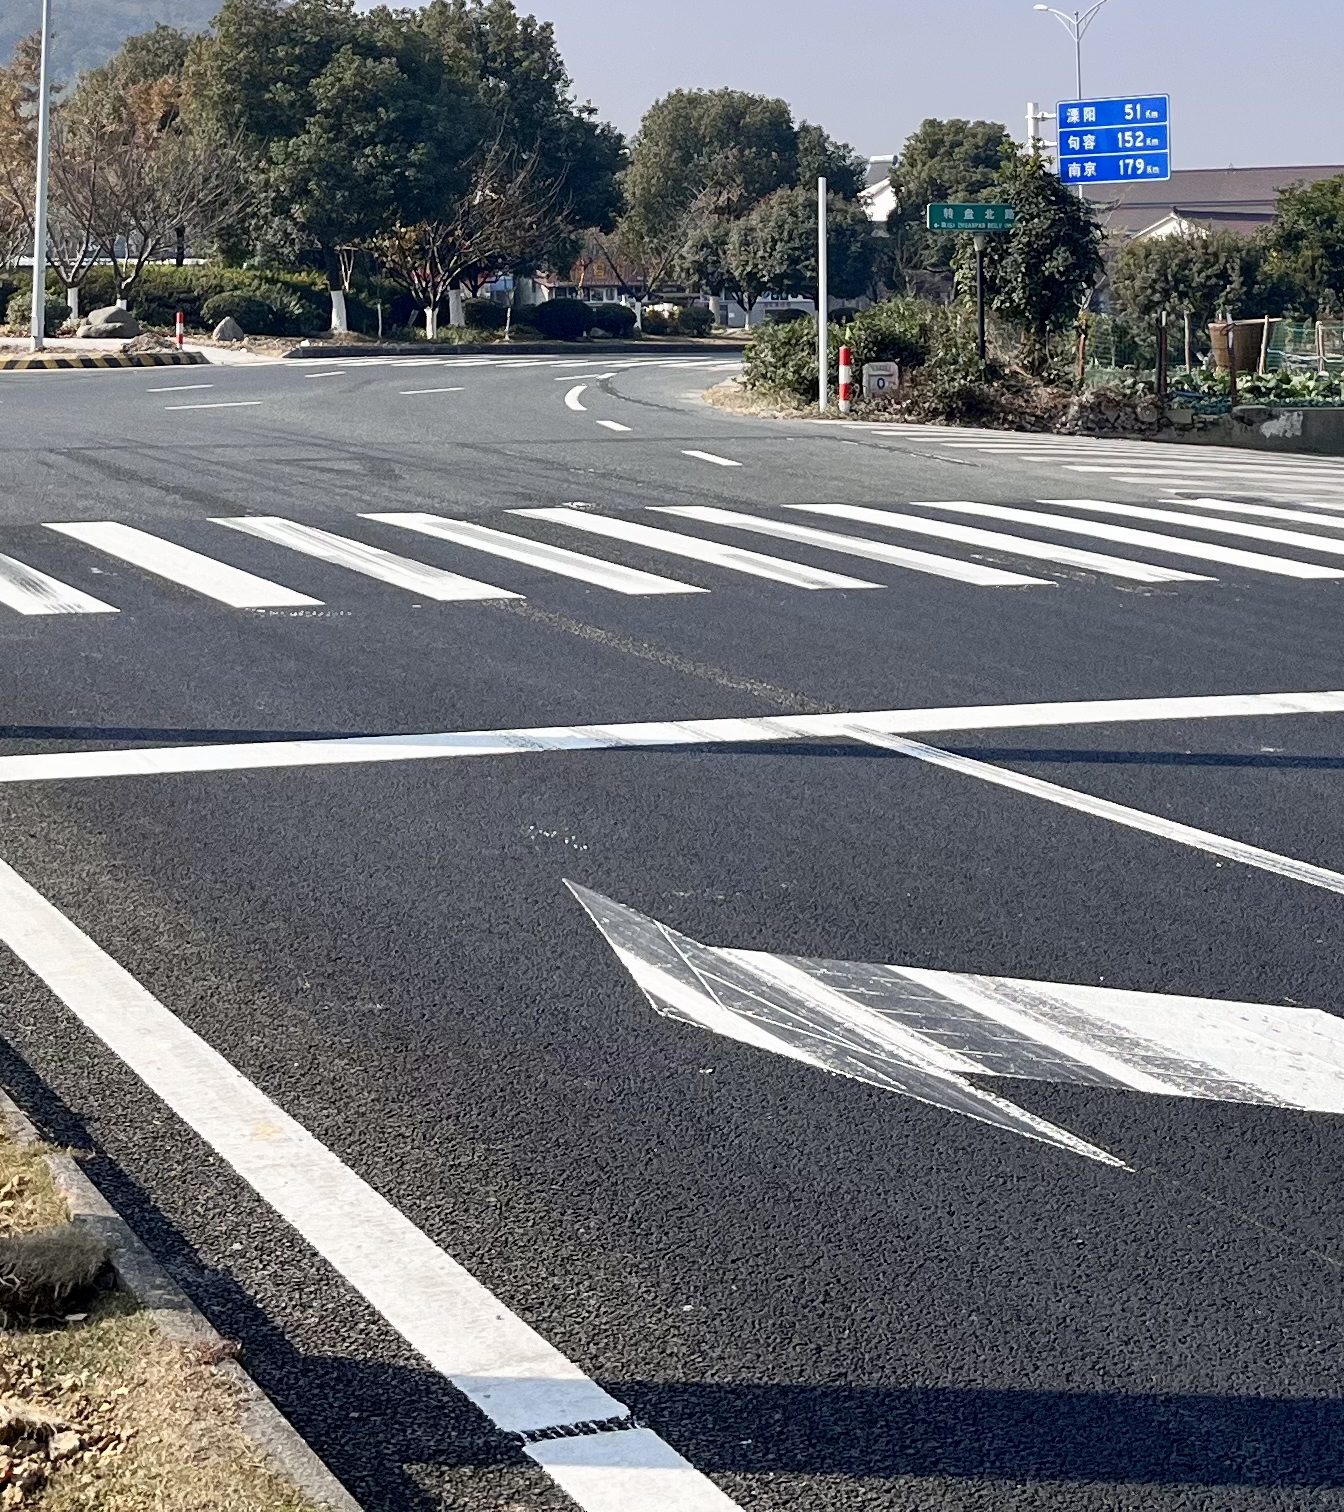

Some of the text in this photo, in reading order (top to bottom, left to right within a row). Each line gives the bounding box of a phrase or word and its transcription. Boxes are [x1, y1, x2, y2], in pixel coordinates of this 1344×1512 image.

[1066, 103, 1159, 124] 溧阳 51 Km
[1067, 131, 1159, 151] 句容 152 Km
[1067, 158, 1160, 178] 南京 179 Km
[876, 377, 886, 390] 0
